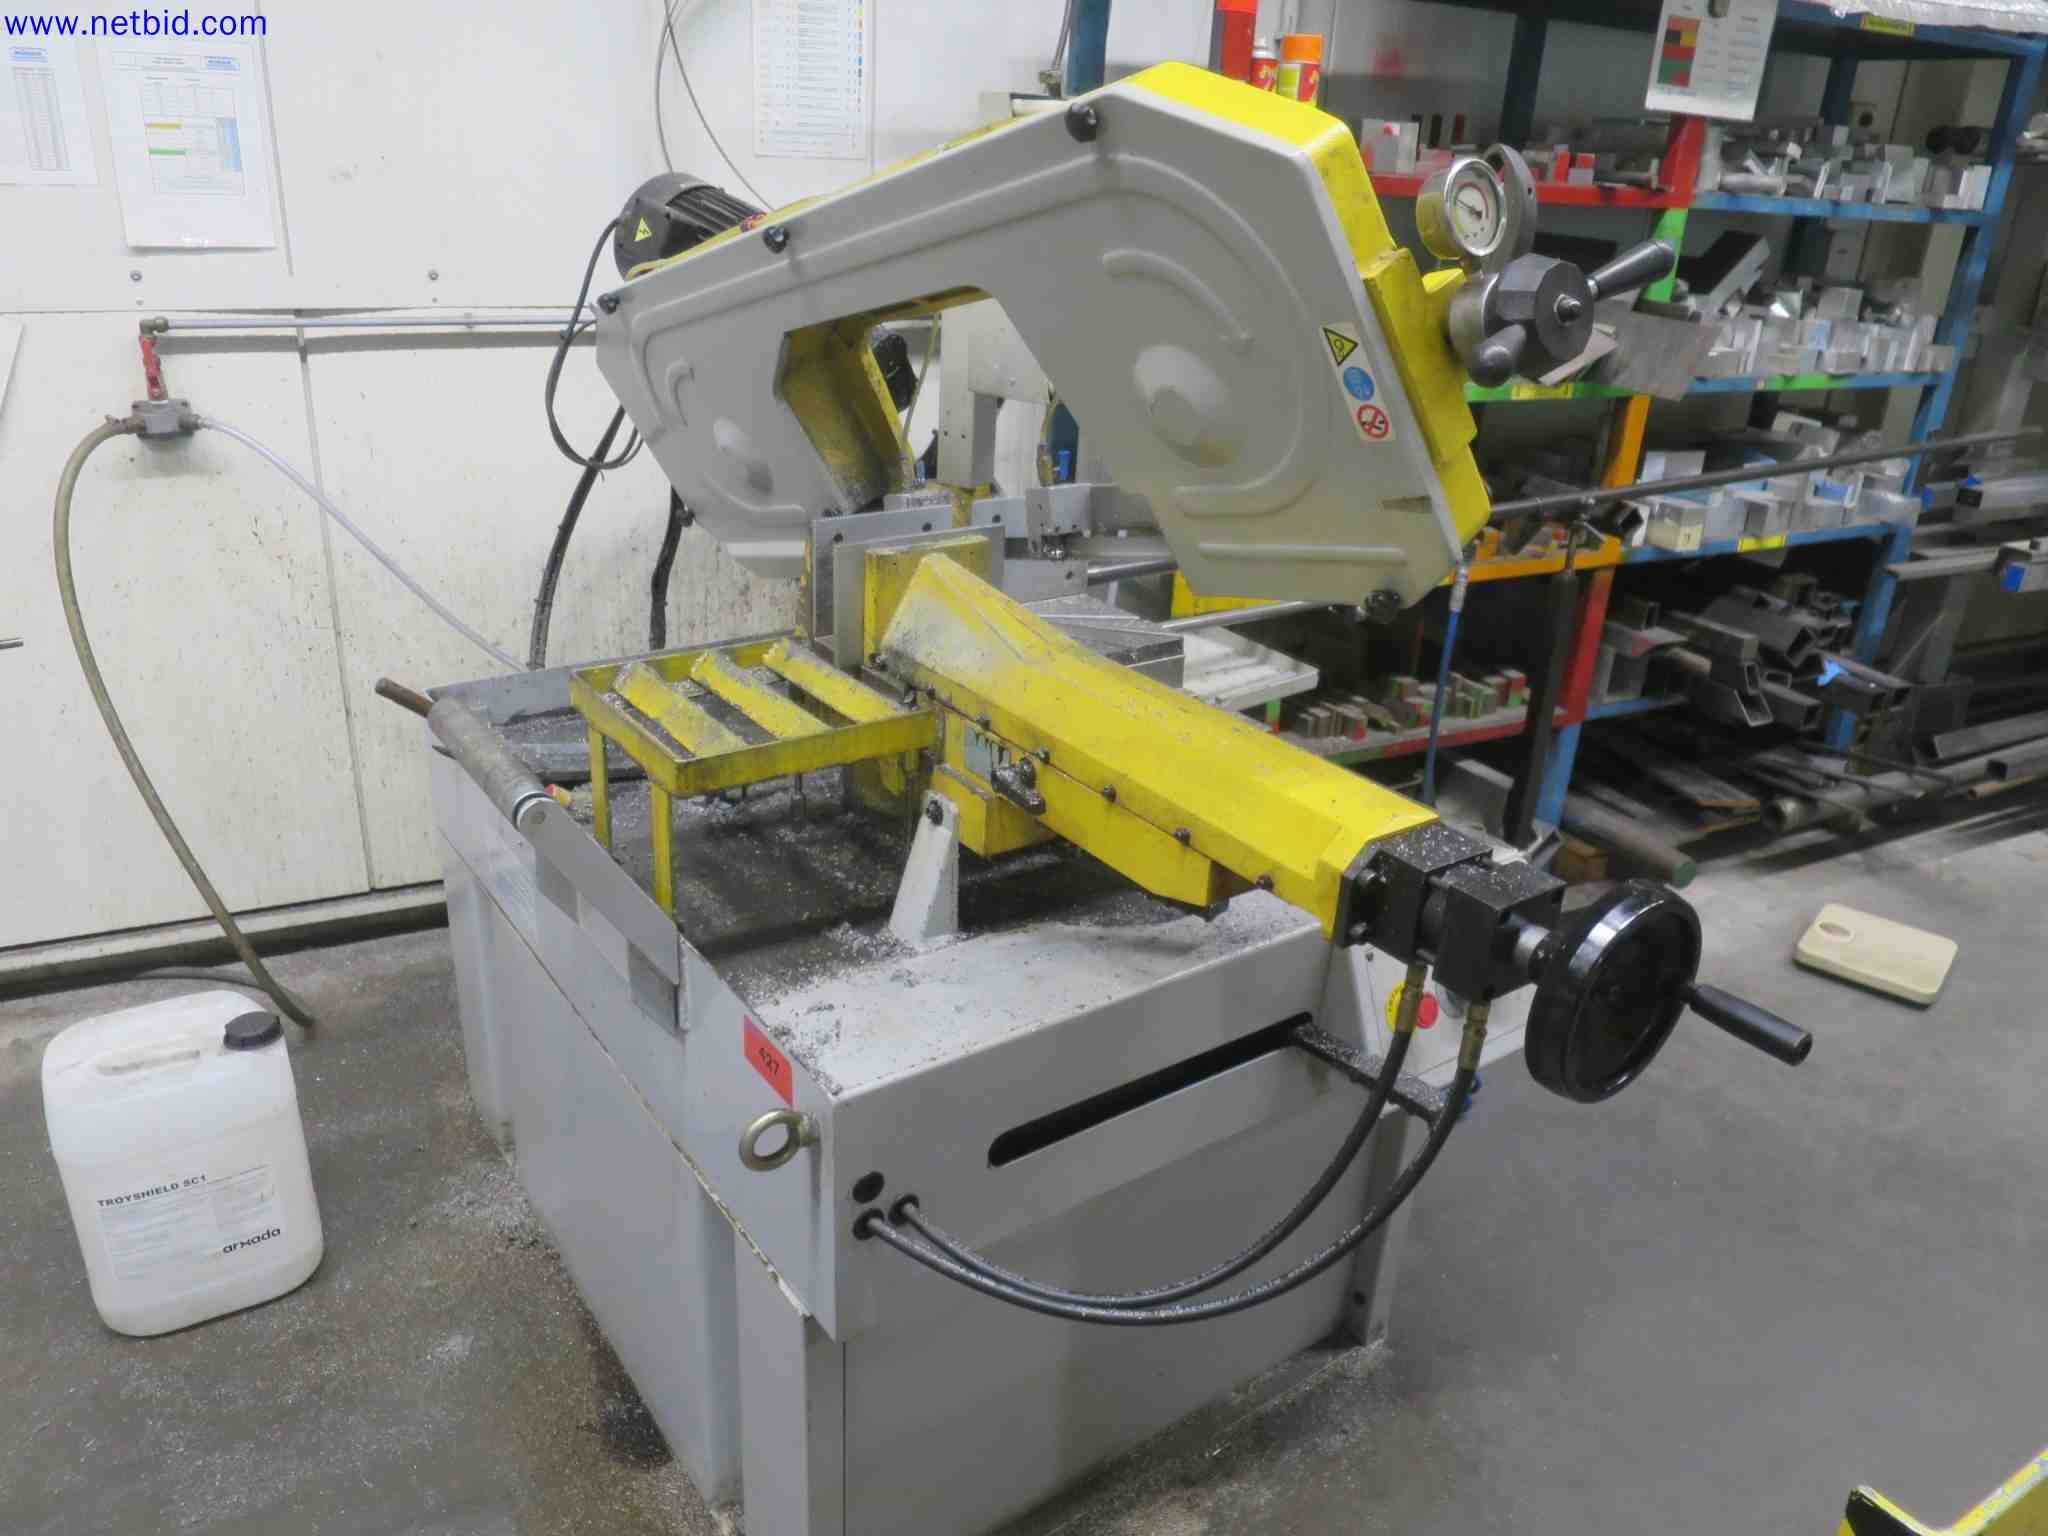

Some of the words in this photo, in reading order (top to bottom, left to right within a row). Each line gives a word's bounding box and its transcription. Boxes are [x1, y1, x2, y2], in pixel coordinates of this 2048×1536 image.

[97, 1183, 179, 1208] TROYSHIELD
[183, 1174, 207, 1188] SC1
[222, 1226, 282, 1254] arxada
